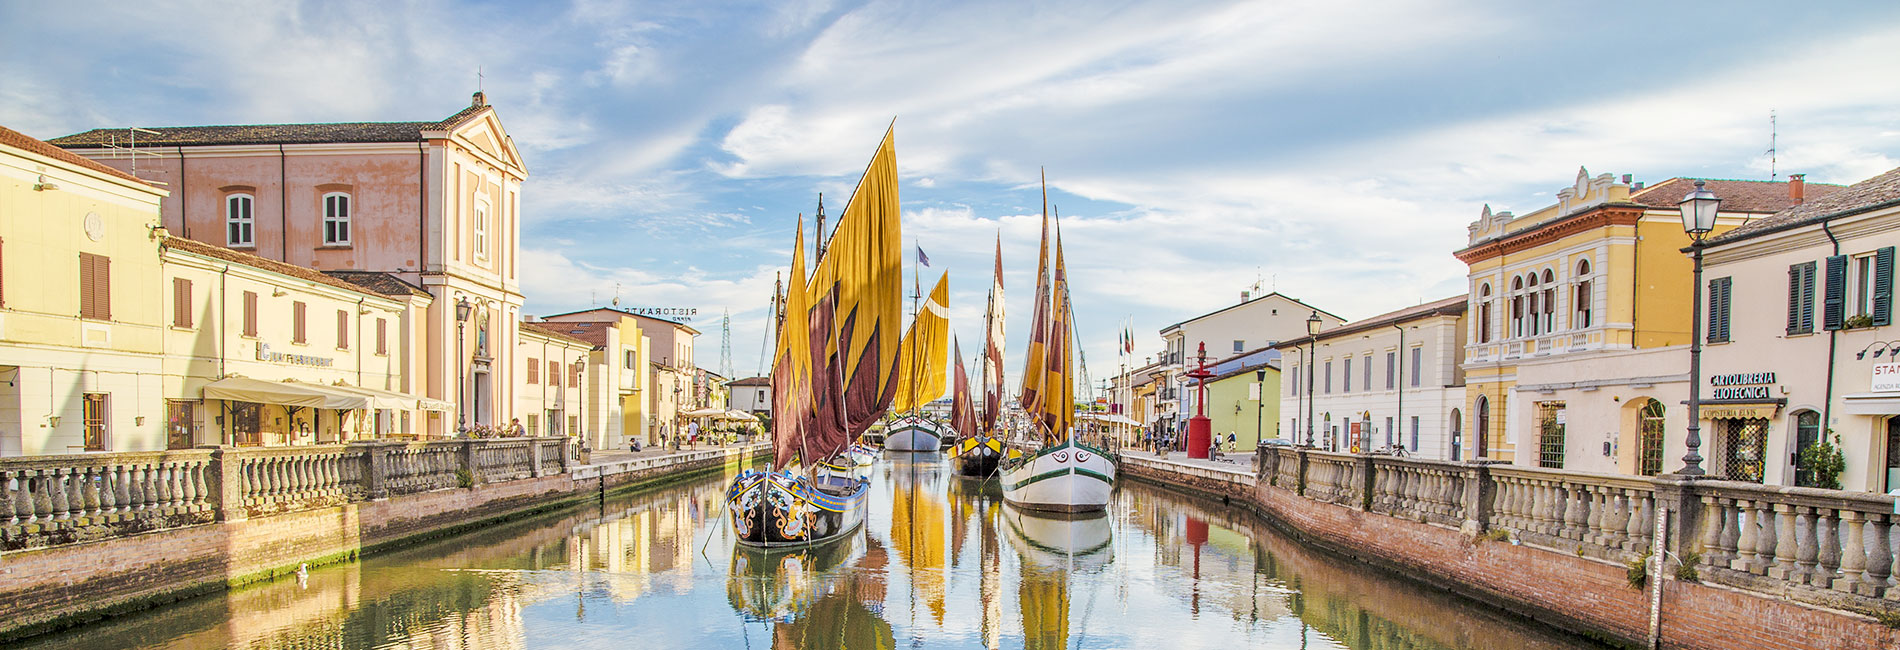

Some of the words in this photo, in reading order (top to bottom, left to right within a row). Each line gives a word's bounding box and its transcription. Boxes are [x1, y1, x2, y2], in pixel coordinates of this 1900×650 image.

[1710, 372, 1776, 386] CARTOLIBRERIA
[1713, 386, 1769, 399] ELIOTECNICA
[1703, 409, 1737, 417] COPISTERIA
